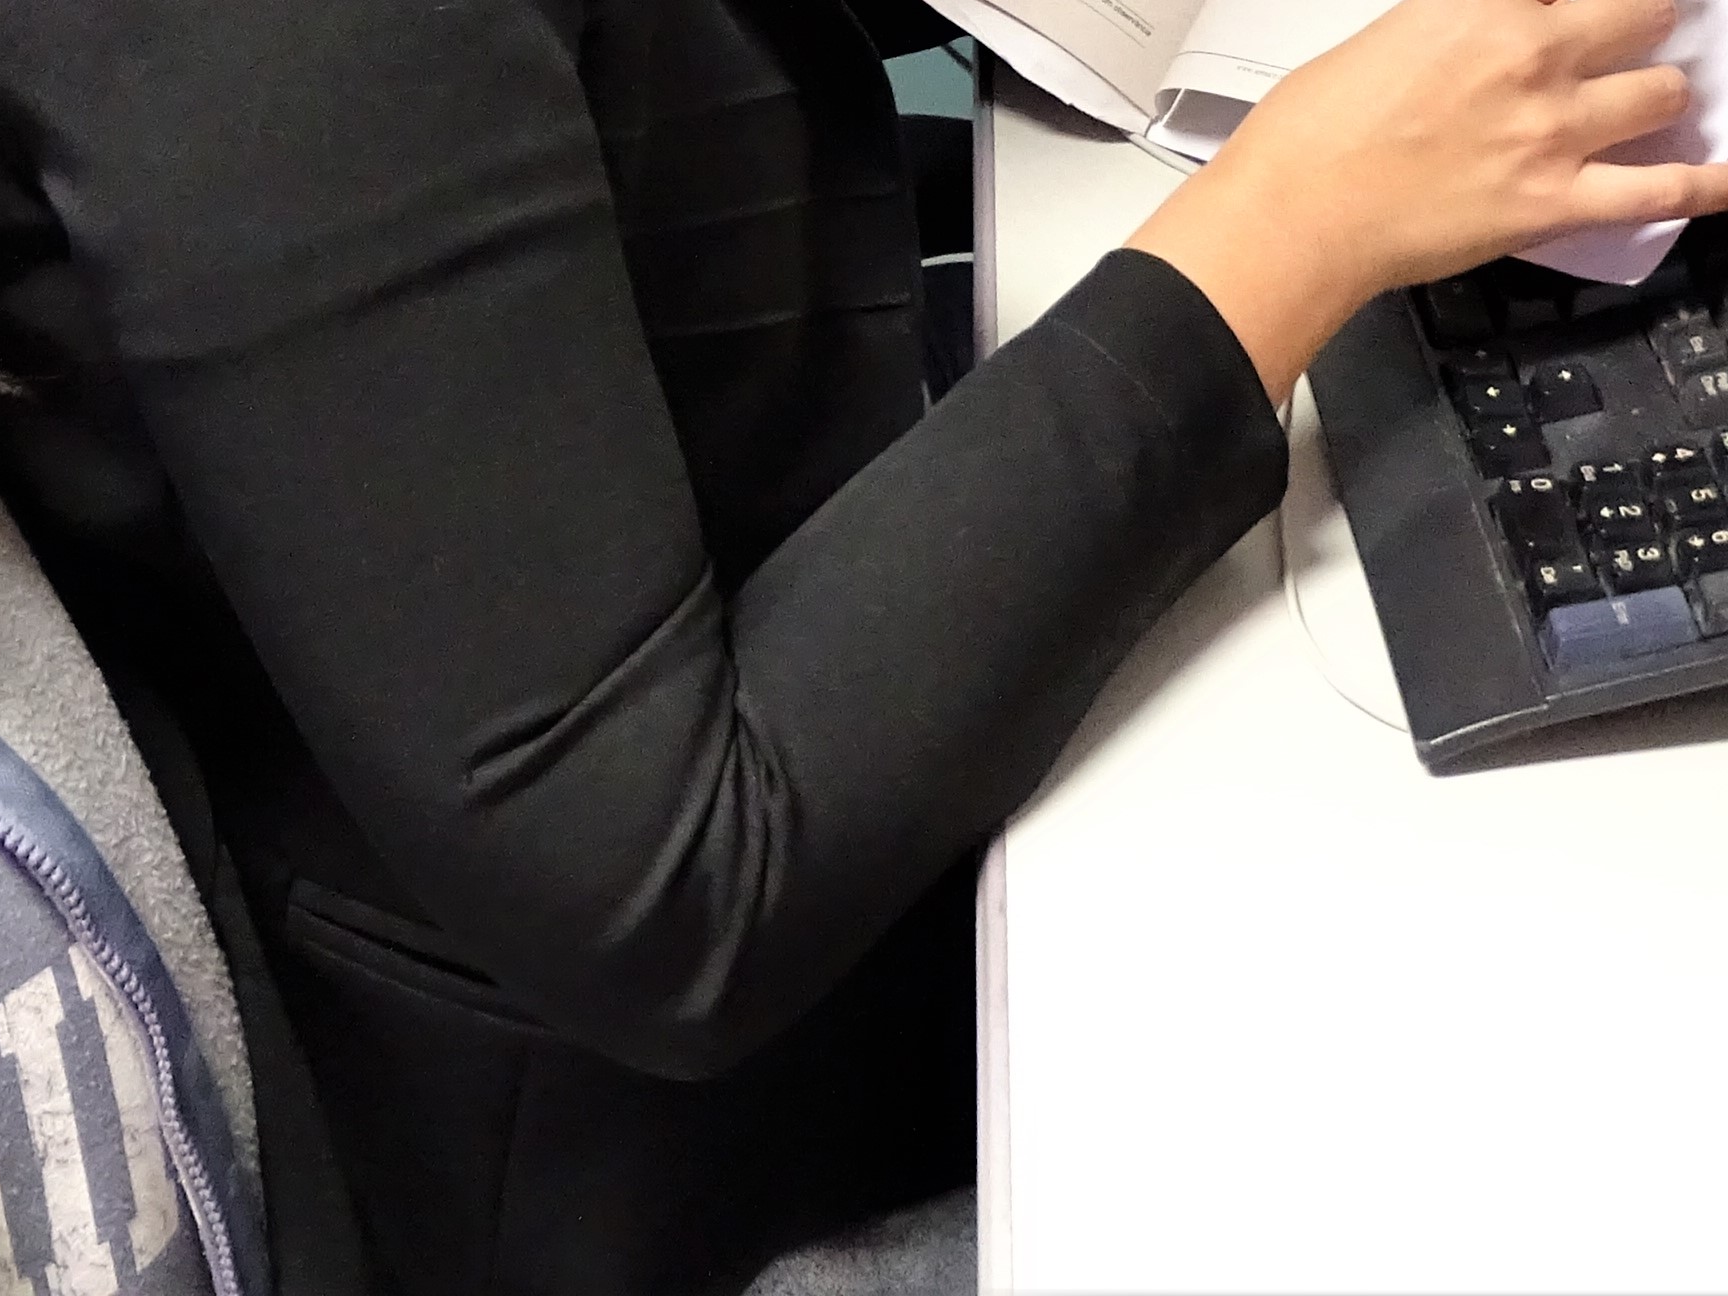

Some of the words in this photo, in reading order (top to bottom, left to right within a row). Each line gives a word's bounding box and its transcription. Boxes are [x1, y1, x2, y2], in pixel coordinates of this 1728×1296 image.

[1530, 477, 1553, 491] 0
[1690, 487, 1717, 502] 5
[1619, 505, 1642, 517] 2
[1637, 546, 1660, 560] 3
